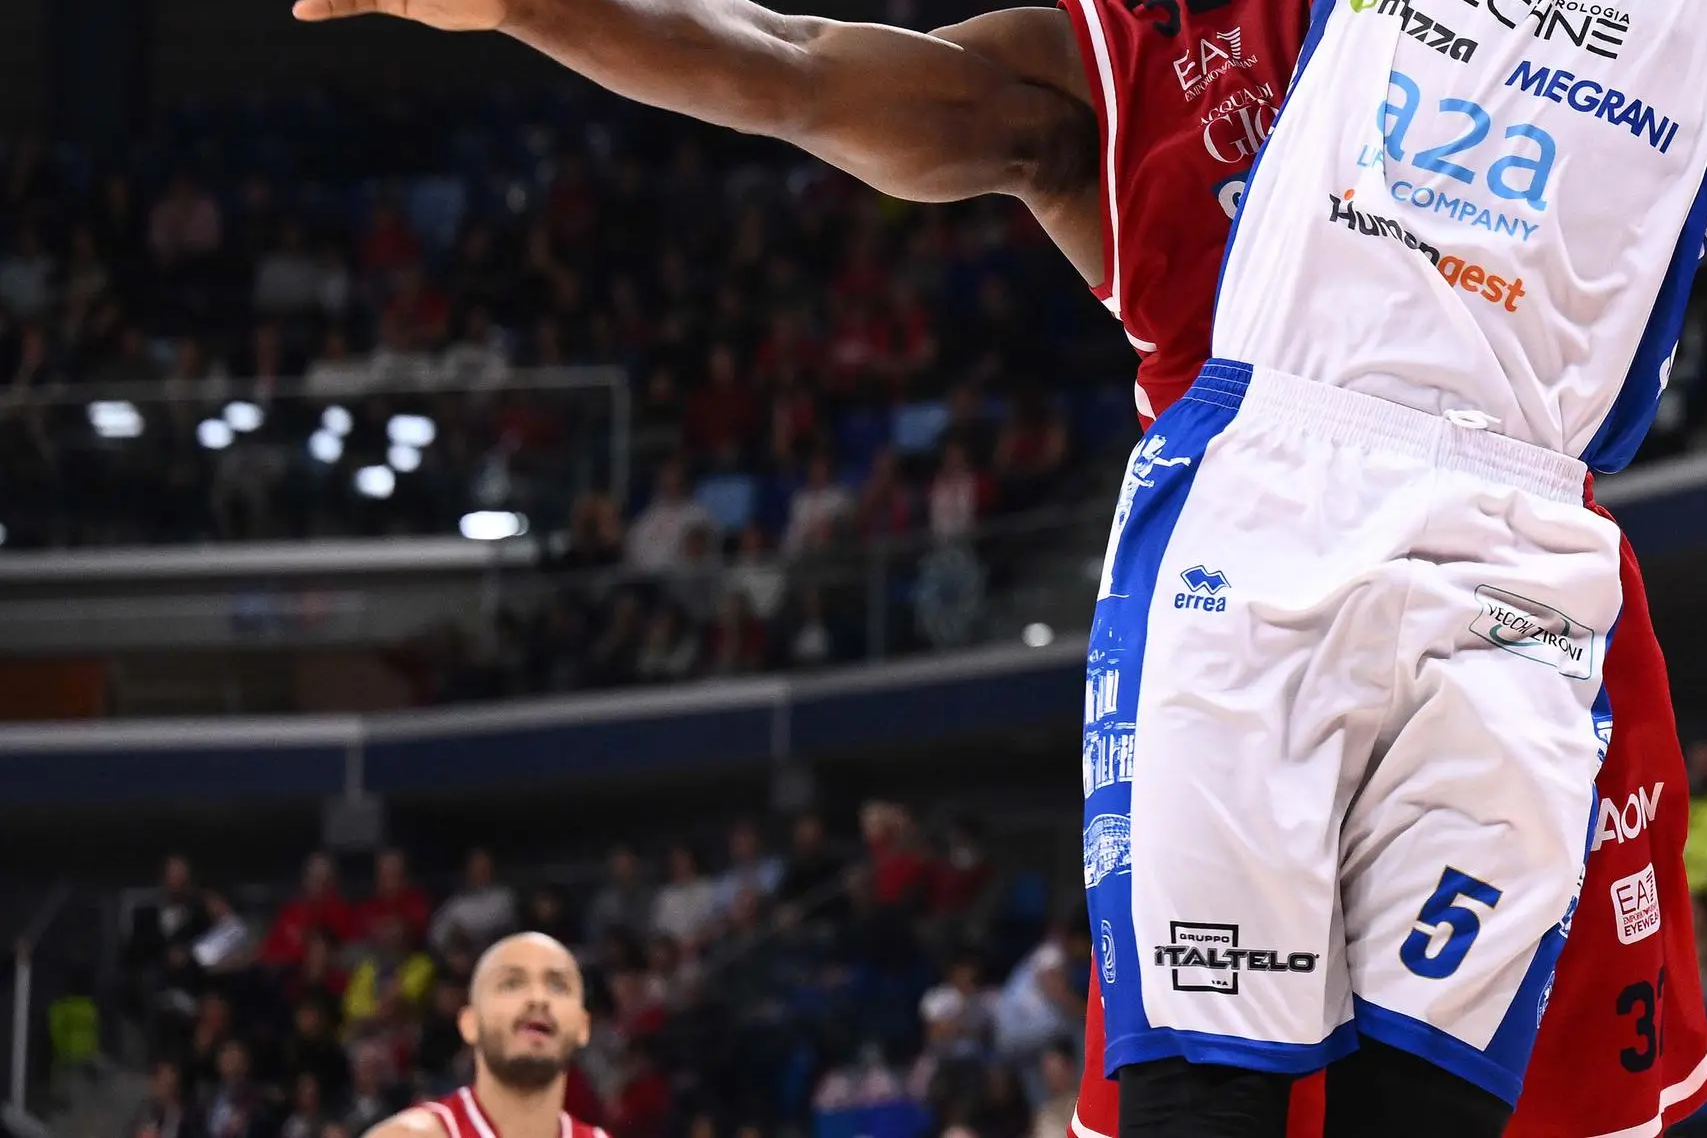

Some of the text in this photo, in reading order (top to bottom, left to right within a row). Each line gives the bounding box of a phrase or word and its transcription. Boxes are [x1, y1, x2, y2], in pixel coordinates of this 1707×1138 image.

[1504, 60, 1679, 155] MEGRANI
[1376, 69, 1558, 211] a2a
[1391, 181, 1539, 241] COMPANY
[1174, 593, 1226, 612] errea
[1529, 626, 1583, 661] ZIRONI
[1590, 782, 1664, 852] AON
[1179, 932, 1230, 943] GRUPPO
[1399, 864, 1503, 981] 5
[1624, 912, 1659, 937] EYEWEA
